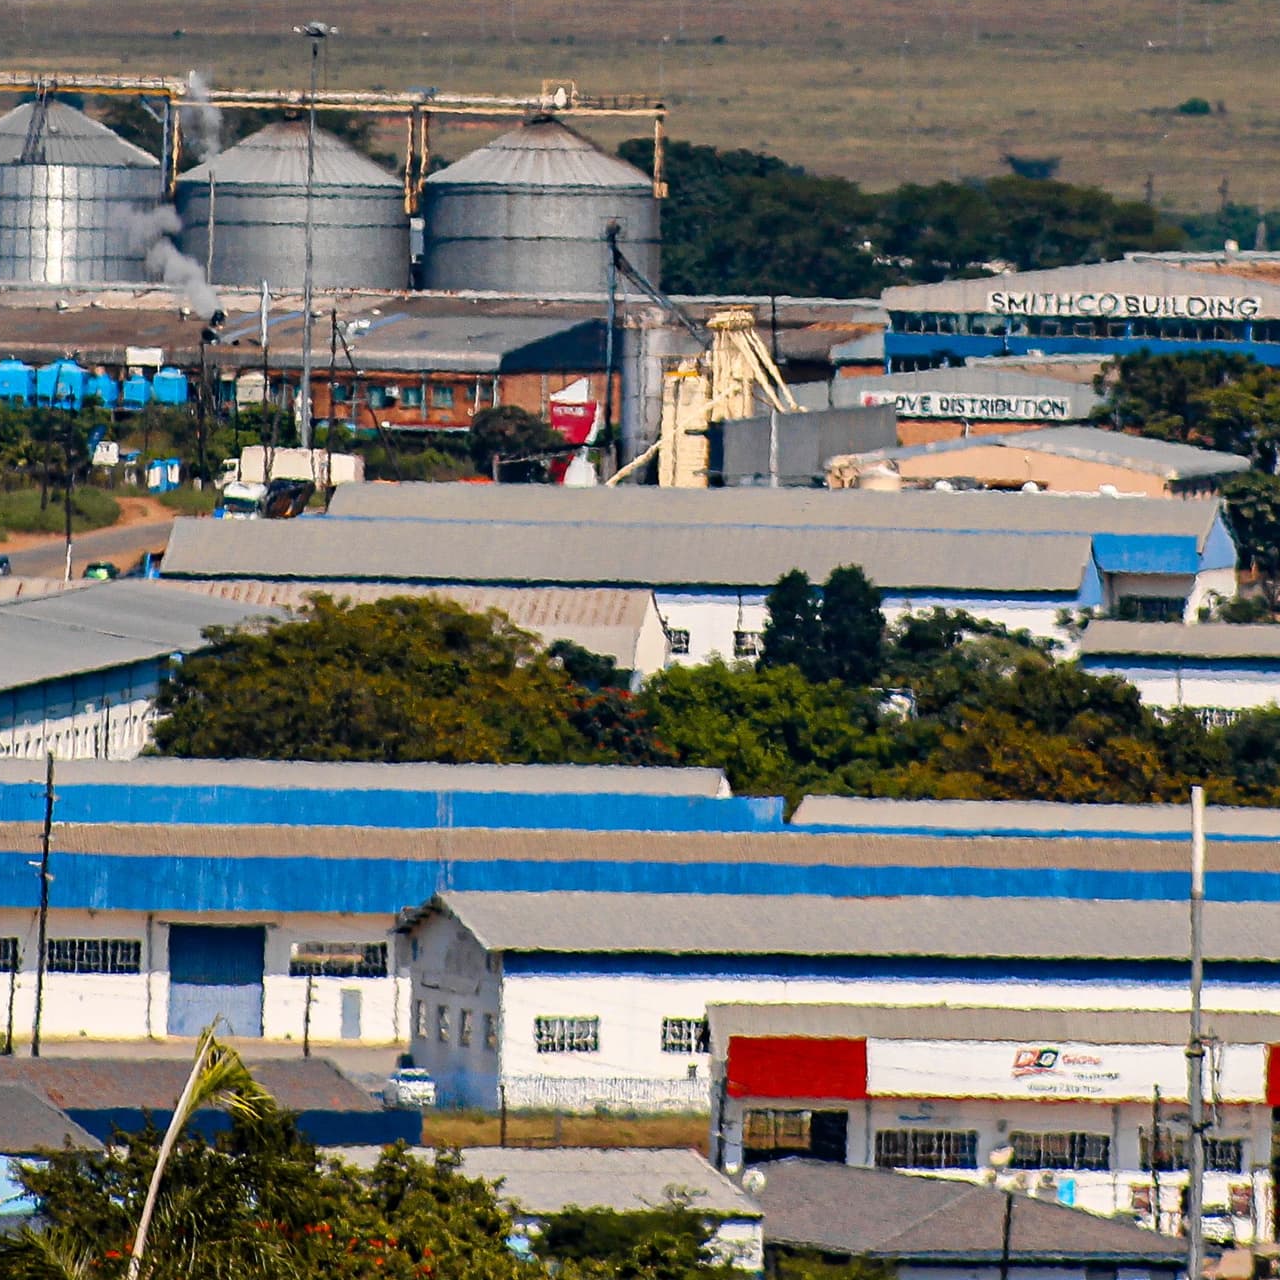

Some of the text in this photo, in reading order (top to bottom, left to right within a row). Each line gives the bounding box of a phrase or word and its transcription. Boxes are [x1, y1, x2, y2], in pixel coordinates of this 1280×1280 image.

[991, 291, 1258, 317] SMITHCO BUILDING
[939, 396, 1065, 416] DISTRIBUTION
